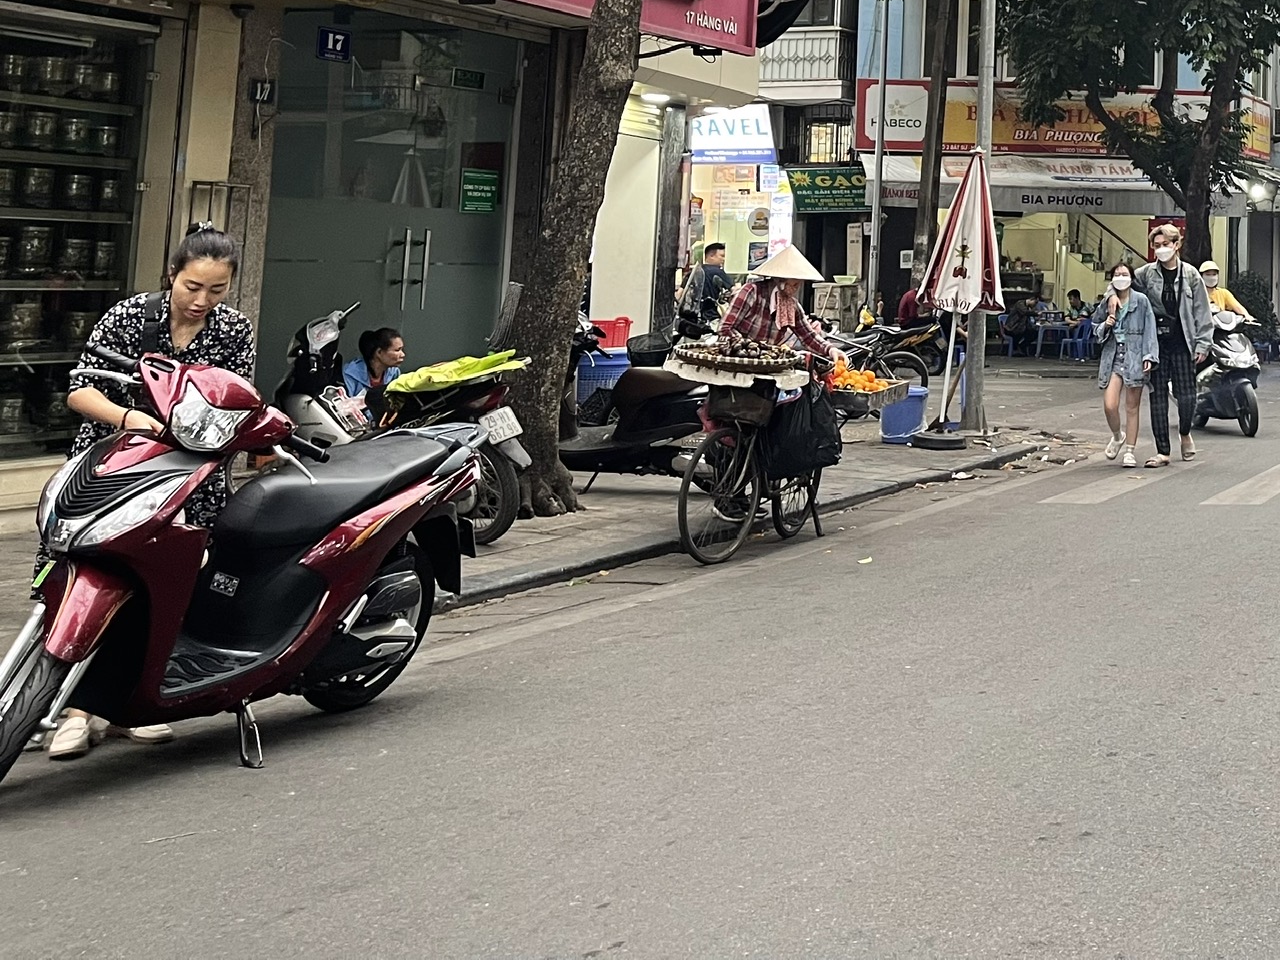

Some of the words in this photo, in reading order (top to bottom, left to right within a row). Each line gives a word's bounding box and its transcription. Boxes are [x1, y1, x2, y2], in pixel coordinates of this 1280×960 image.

[685, 10, 695, 24] 17
[696, 10, 721, 31] HÀNG
[722, 16, 738, 35] VẢI
[327, 33, 345, 51] 17
[255, 82, 271, 100] 17
[966, 104, 1006, 121] BA
[1013, 128, 1038, 141] BIA
[905, 189, 920, 199] BEE
[1021, 194, 1044, 205] BIA
